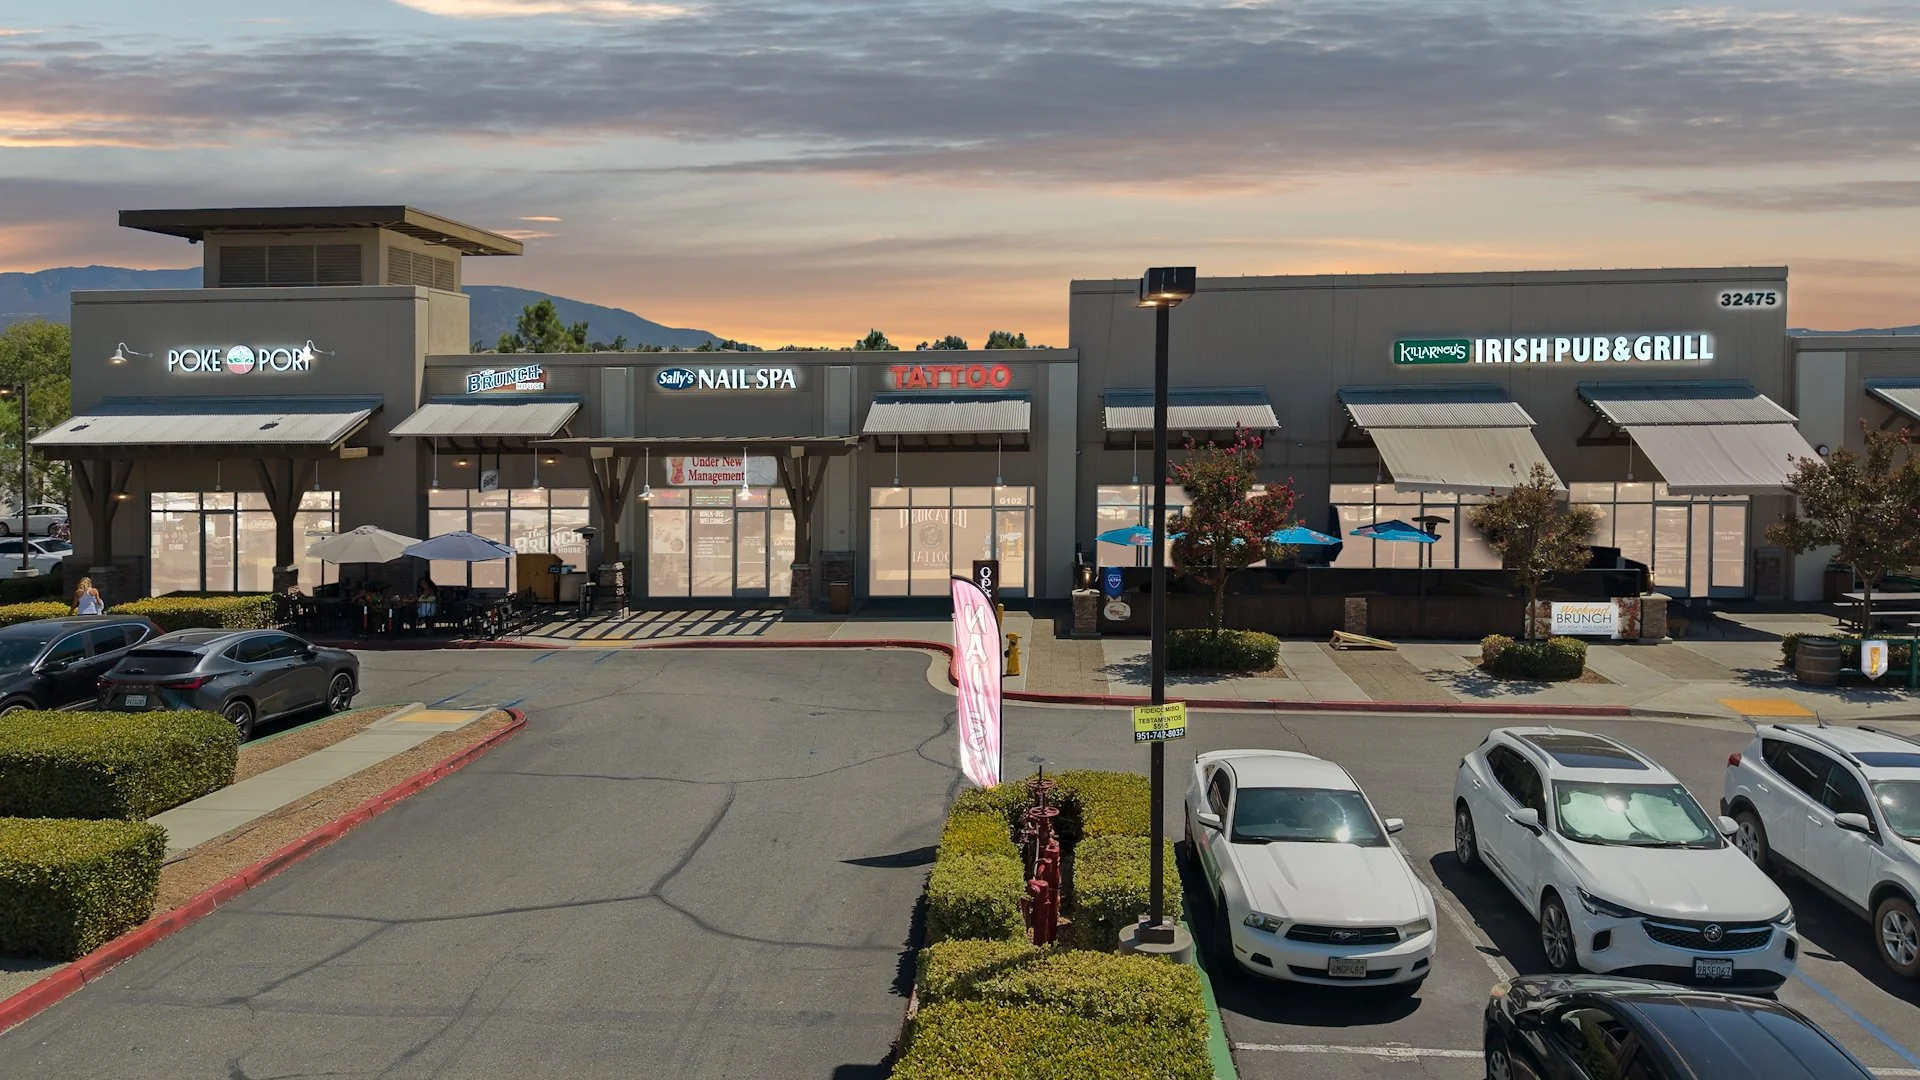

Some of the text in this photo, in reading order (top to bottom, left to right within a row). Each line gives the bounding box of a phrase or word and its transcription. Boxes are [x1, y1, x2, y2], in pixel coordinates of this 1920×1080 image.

[1721, 292, 1776, 306] 32475
[1475, 337, 1548, 363] IRISH
[168, 349, 222, 372] POKE
[466, 364, 542, 394] BRUNCH
[659, 368, 797, 390] Sally's NAIL SPA
[890, 364, 1012, 389] TATTOO
[692, 456, 743, 467] Under New
[688, 469, 745, 484] Management
[999, 497, 1023, 505] G102
[1561, 604, 1610, 614] Weekend
[1556, 614, 1611, 623] BRUNCH
[1138, 715, 1182, 724] TESTAMENTOS
